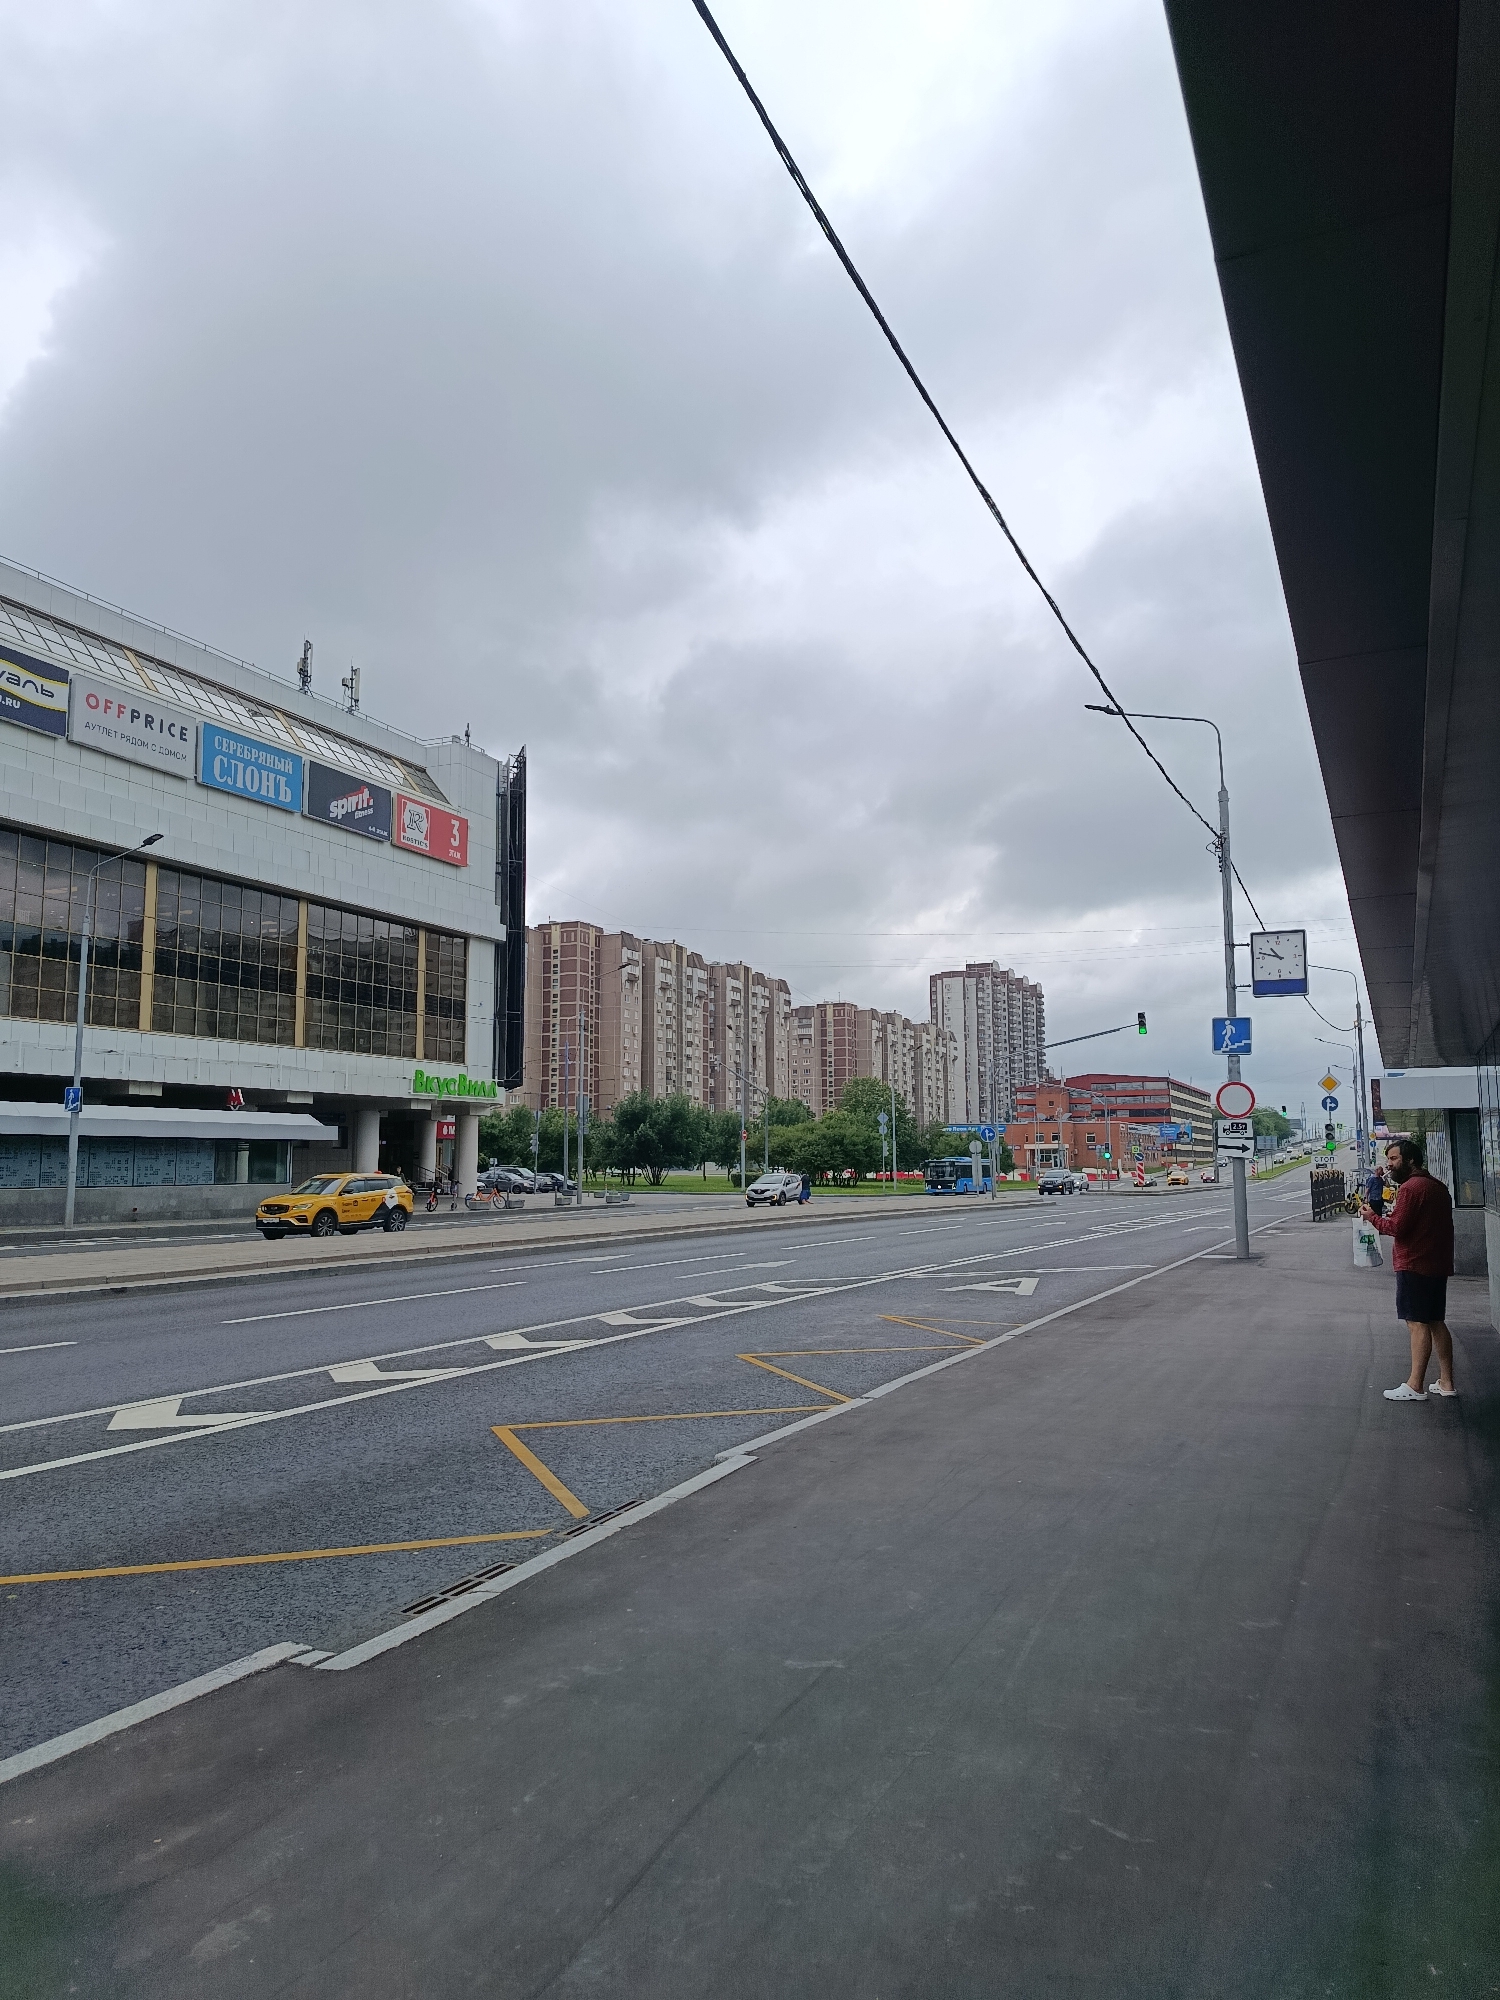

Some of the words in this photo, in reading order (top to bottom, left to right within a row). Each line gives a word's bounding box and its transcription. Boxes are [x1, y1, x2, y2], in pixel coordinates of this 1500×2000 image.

[85, 693, 188, 742] OFFPRICE
[84, 721, 118, 739] АУТЛЕТ
[120, 733, 149, 750] РЯДОМ
[151, 743, 157, 752] С
[158, 746, 187, 761] ДОМОМ
[214, 736, 293, 774] СЕРЕБРЯНЫЙ
[213, 755, 292, 803] СЛОНЪ
[450, 818, 460, 847] 3
[414, 1069, 498, 1099] ВкусВилл
